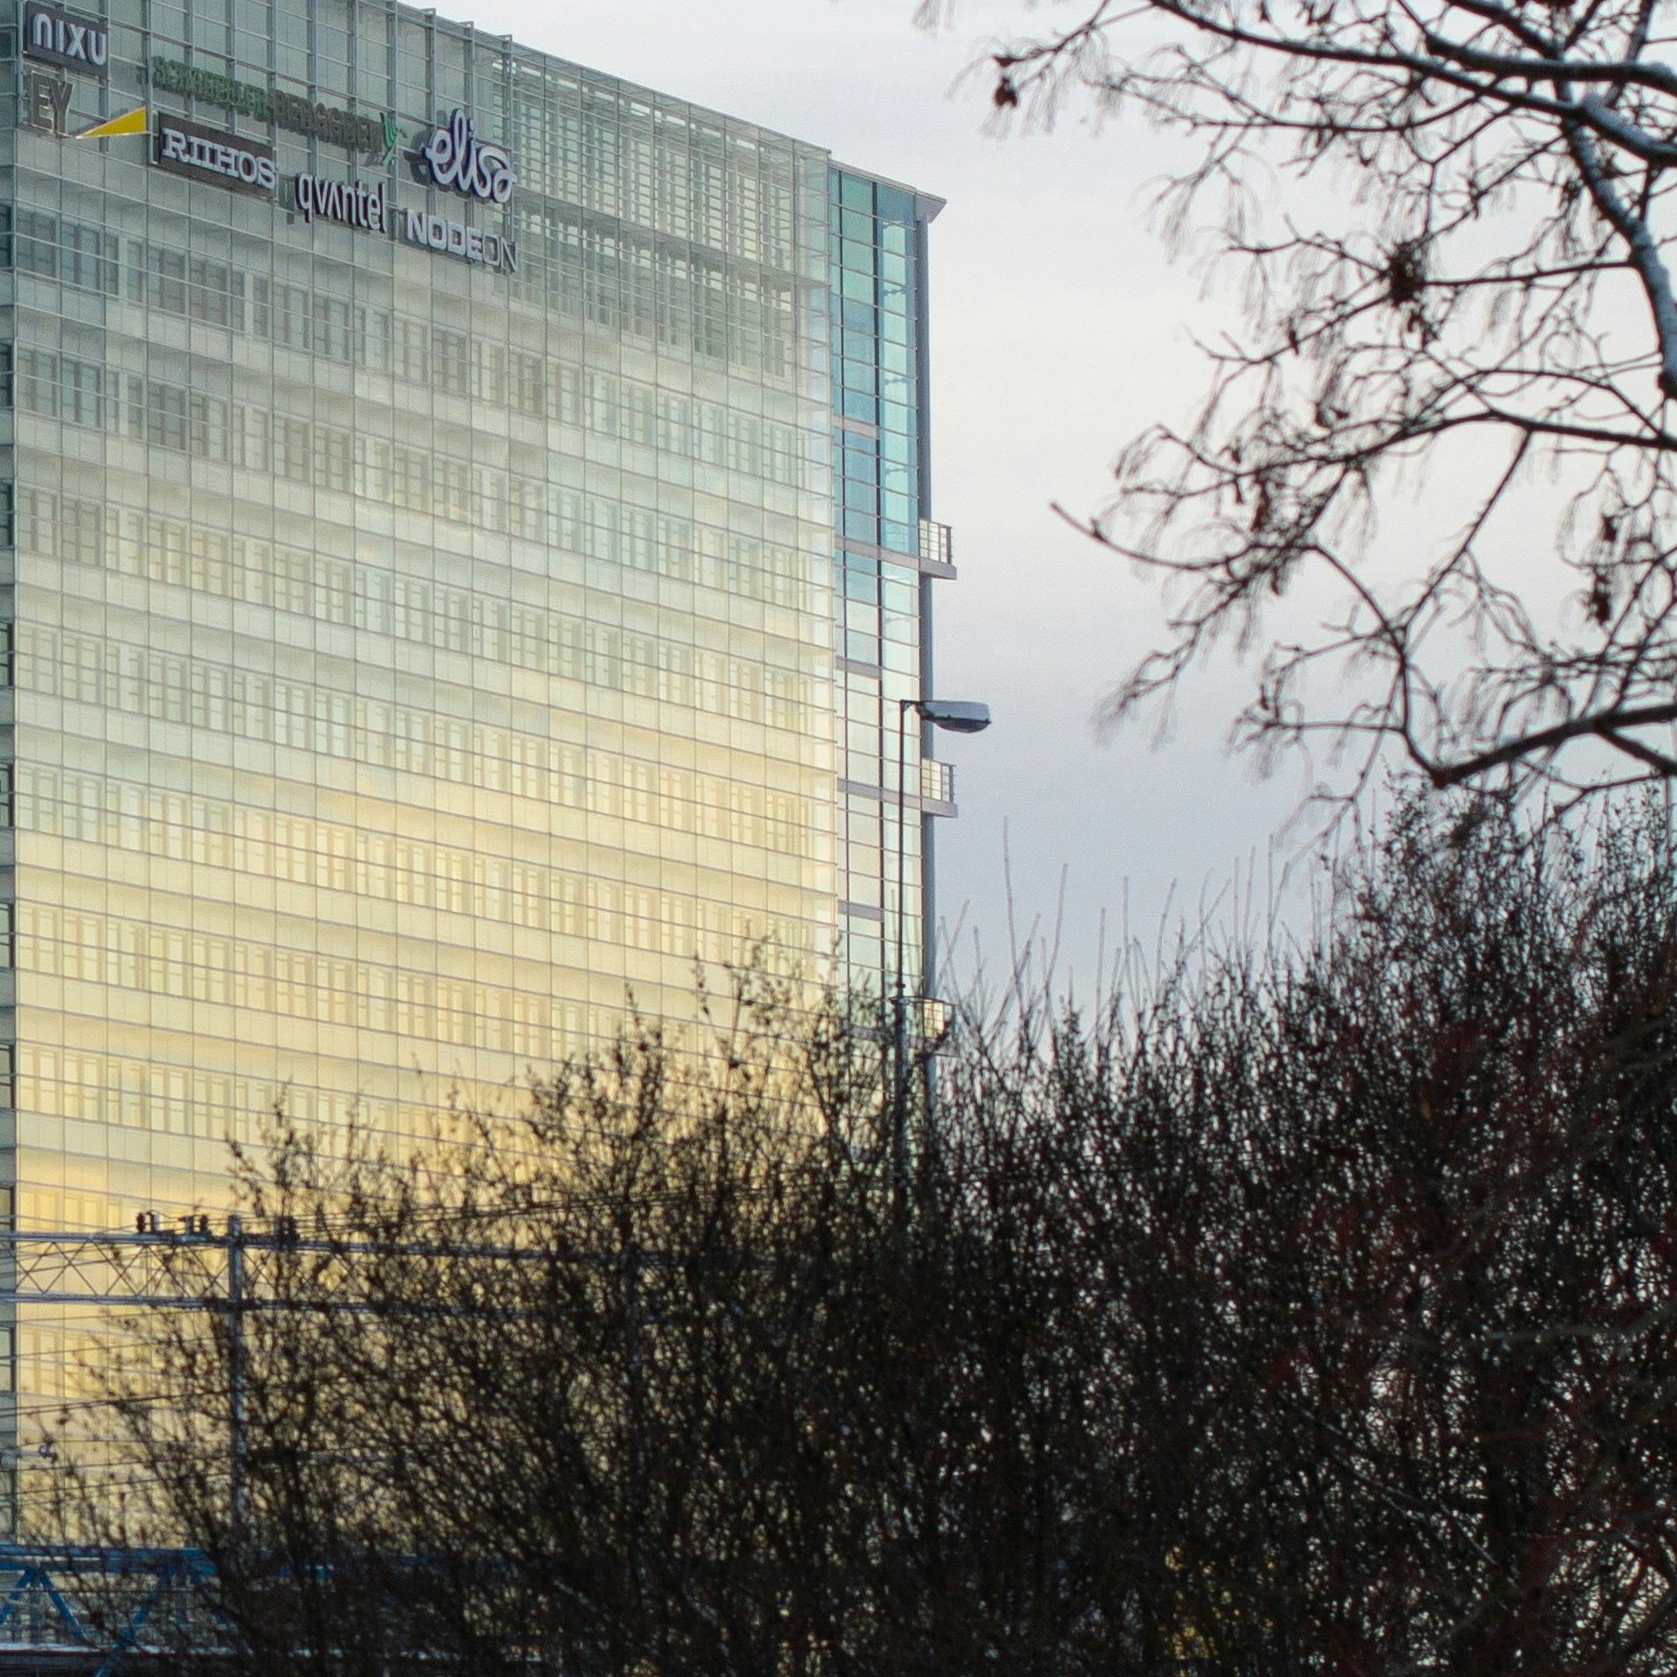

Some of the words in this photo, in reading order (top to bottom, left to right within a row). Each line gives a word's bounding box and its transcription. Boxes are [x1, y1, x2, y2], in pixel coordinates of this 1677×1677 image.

[33, 13, 107, 66] nixu
[31, 71, 74, 139] EY
[162, 128, 275, 190] RIIHOS
[425, 109, 518, 203] elisa
[407, 208, 519, 272] NODEON
